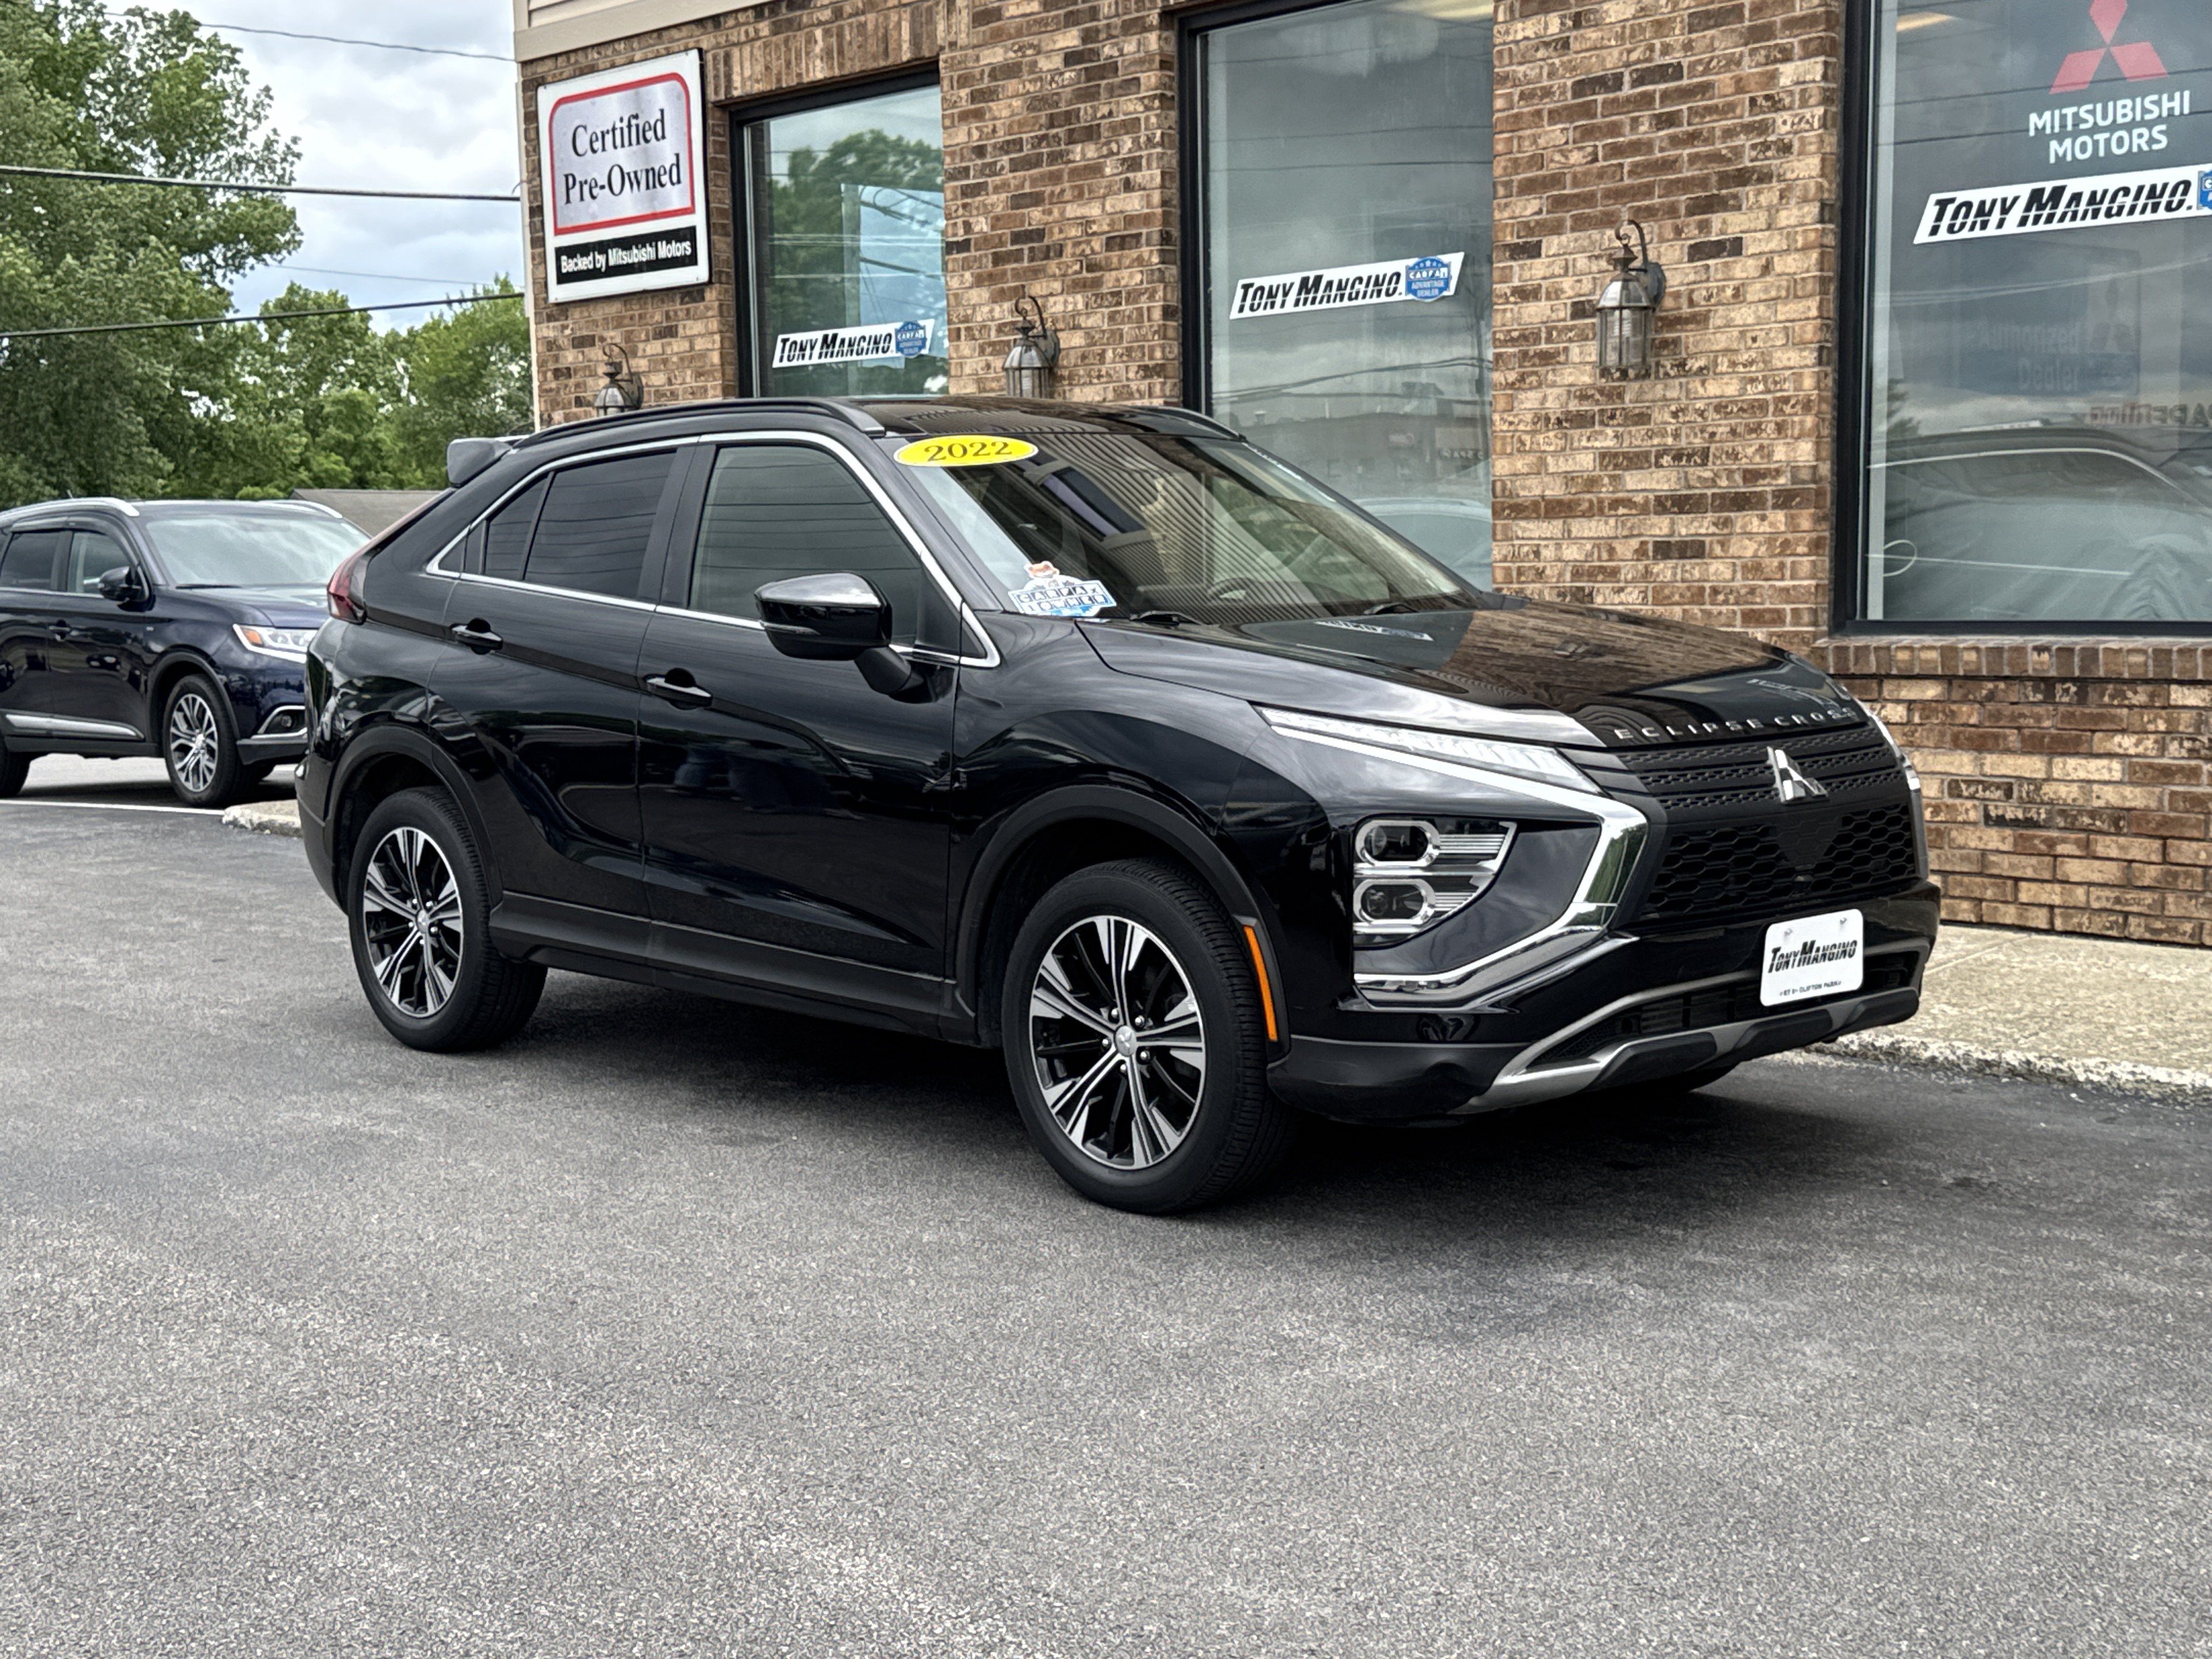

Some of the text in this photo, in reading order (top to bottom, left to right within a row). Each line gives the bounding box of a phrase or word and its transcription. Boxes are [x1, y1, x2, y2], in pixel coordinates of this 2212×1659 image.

[2029, 90, 2190, 137] MITSUBISHI
[572, 109, 667, 157] Certified
[2049, 125, 2168, 164] MOTORS
[563, 153, 681, 205] Pre-Owned
[1928, 195, 2021, 237] TONY
[561, 240, 691, 273] Backed by Mitsubishi Motors
[1238, 282, 1295, 314] TONY
[779, 338, 819, 363] TONY
[924, 441, 1012, 462] 2022
[1615, 719, 1764, 739] ECLIPSE
[1768, 940, 1858, 973] TONY MANGINO
